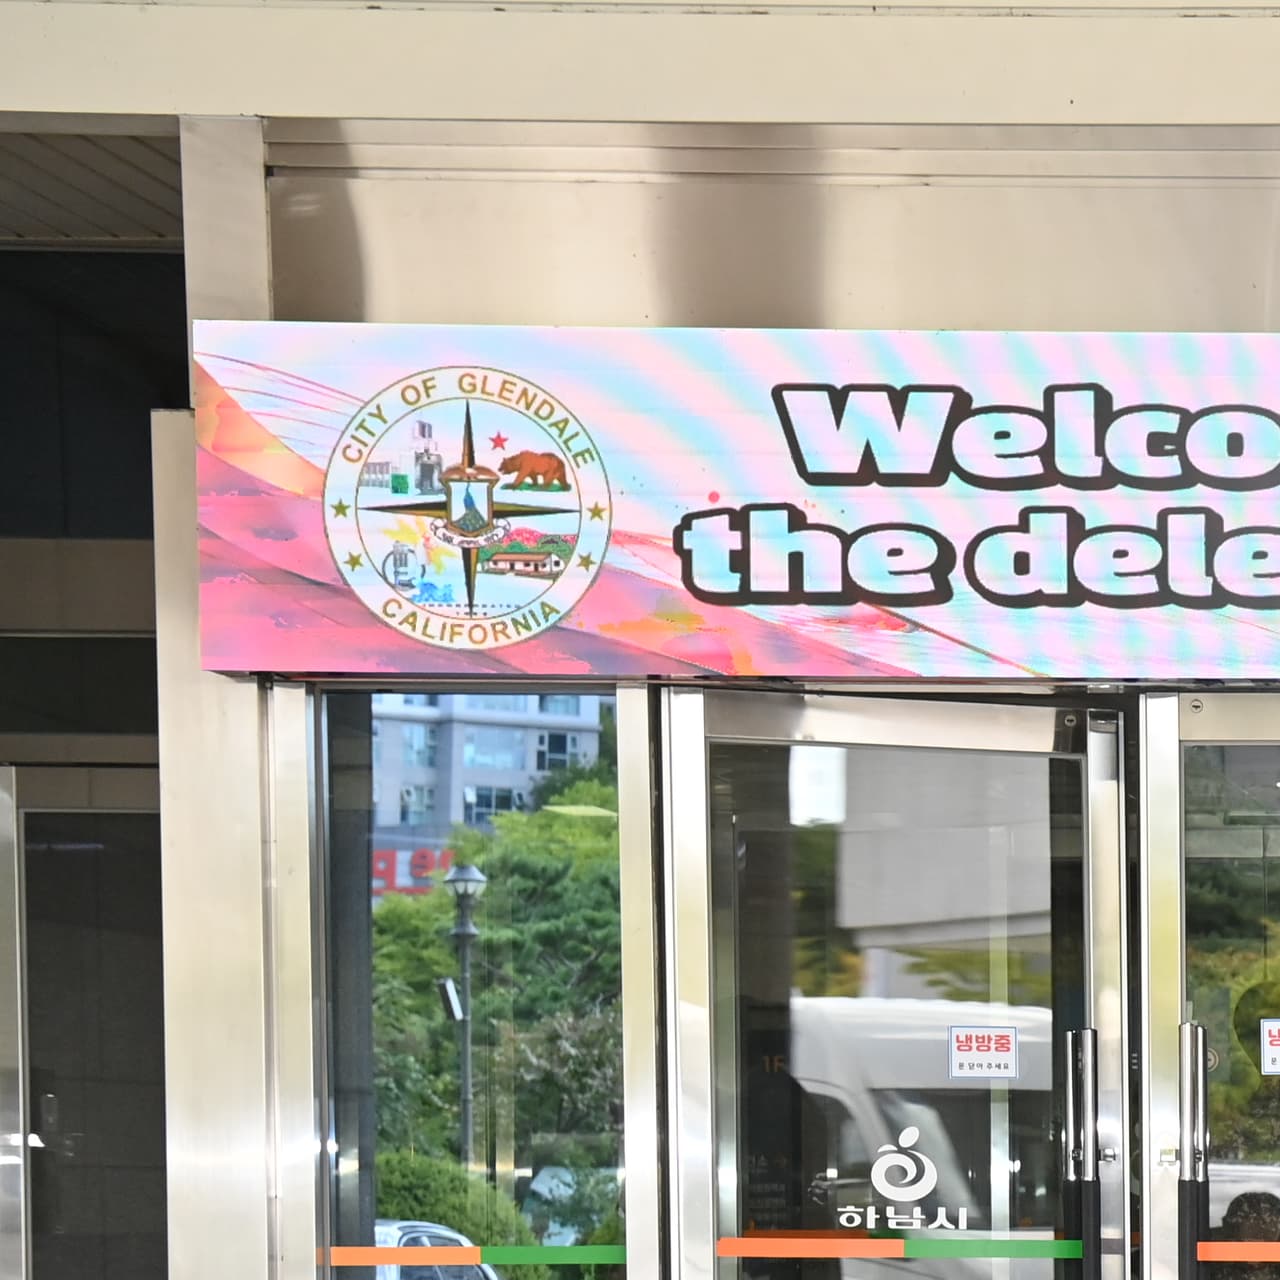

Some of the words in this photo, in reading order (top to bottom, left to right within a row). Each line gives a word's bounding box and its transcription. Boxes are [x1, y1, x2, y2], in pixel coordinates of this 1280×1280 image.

[341, 404, 389, 464] CITY
[400, 376, 438, 407] OF
[457, 373, 596, 469] GLENDALE
[673, 502, 956, 607] the
[382, 598, 561, 645] CALIFORNIA
[956, 1034, 1011, 1053] 냉방중
[986, 1062, 1009, 1070] 주세요
[837, 1205, 968, 1231] 하남시
